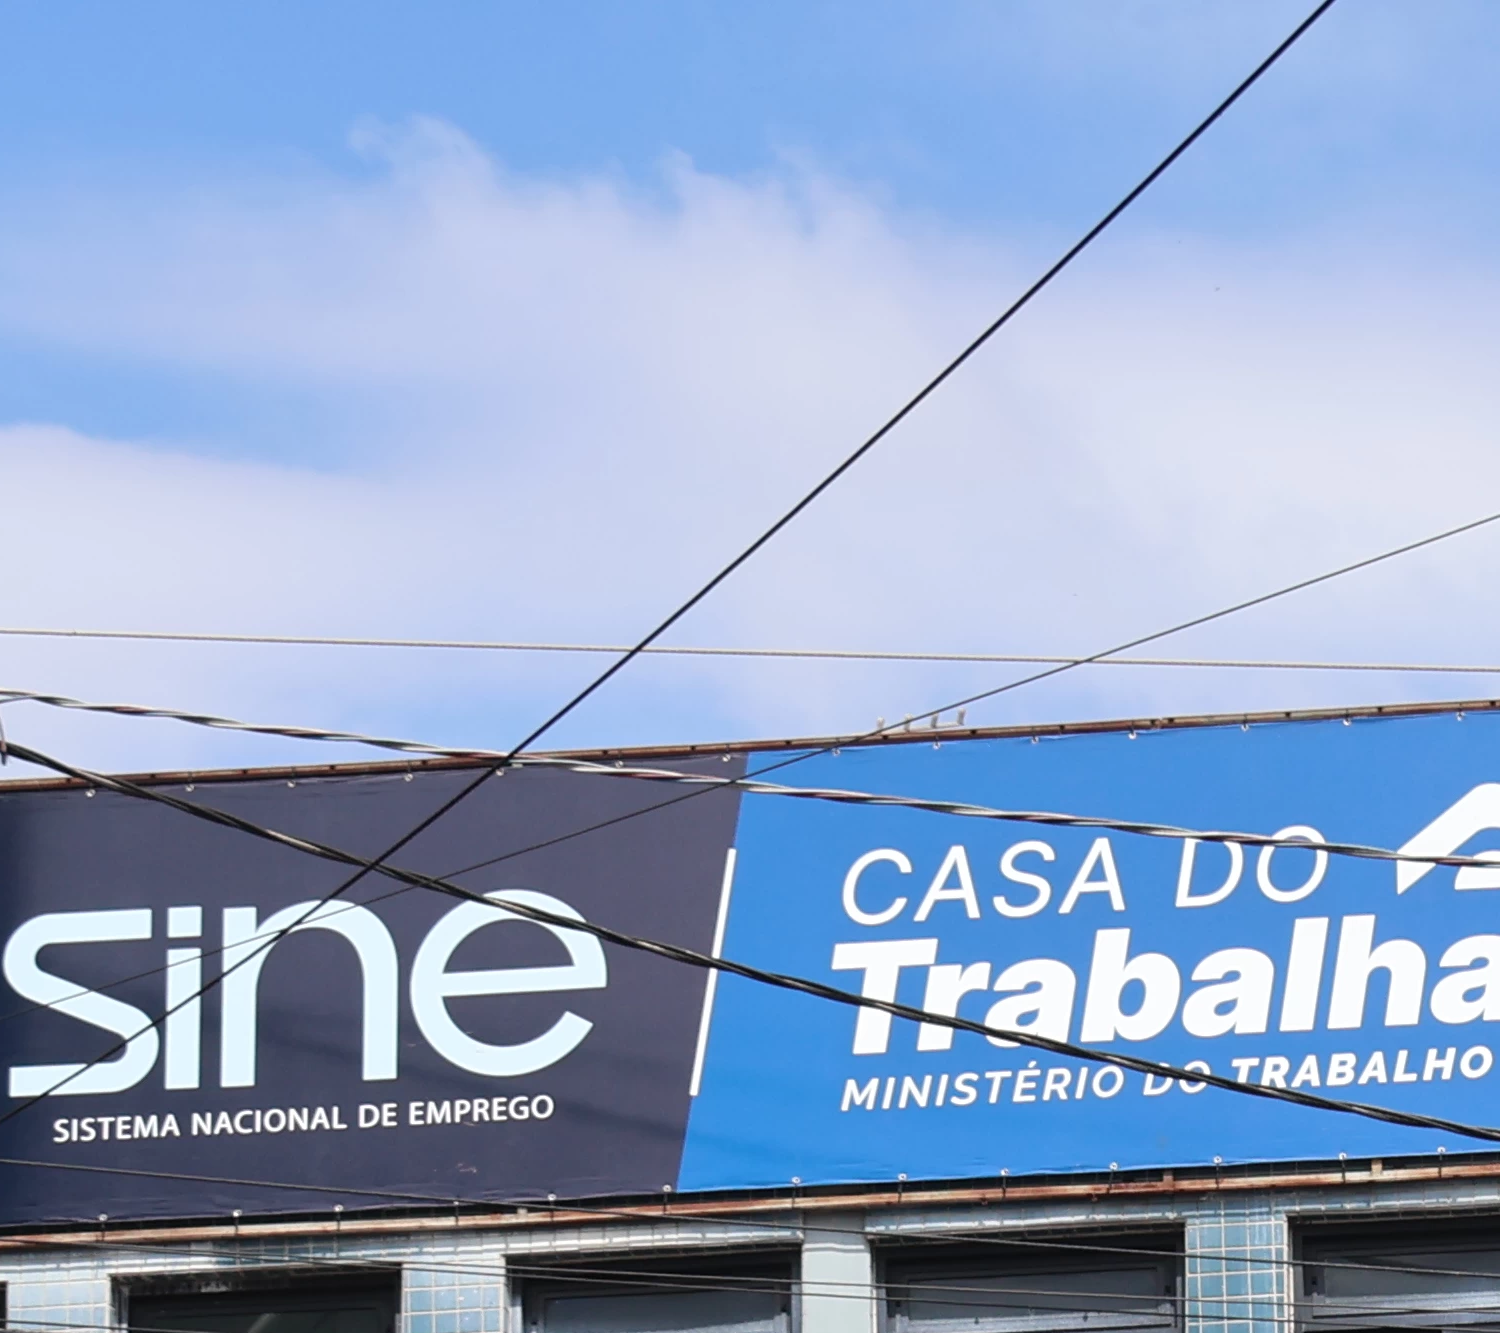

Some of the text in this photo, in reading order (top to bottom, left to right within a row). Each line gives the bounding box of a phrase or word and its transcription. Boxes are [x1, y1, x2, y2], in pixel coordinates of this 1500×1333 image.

[842, 825, 1329, 926] CASA DO
[3, 888, 608, 1098] sine
[53, 1095, 555, 1144] SISTEMA NACIONAL DE EMPREGO
[840, 1061, 1125, 1112] MINISTÉRIO
[1230, 1044, 1494, 1090] TRABALHO
